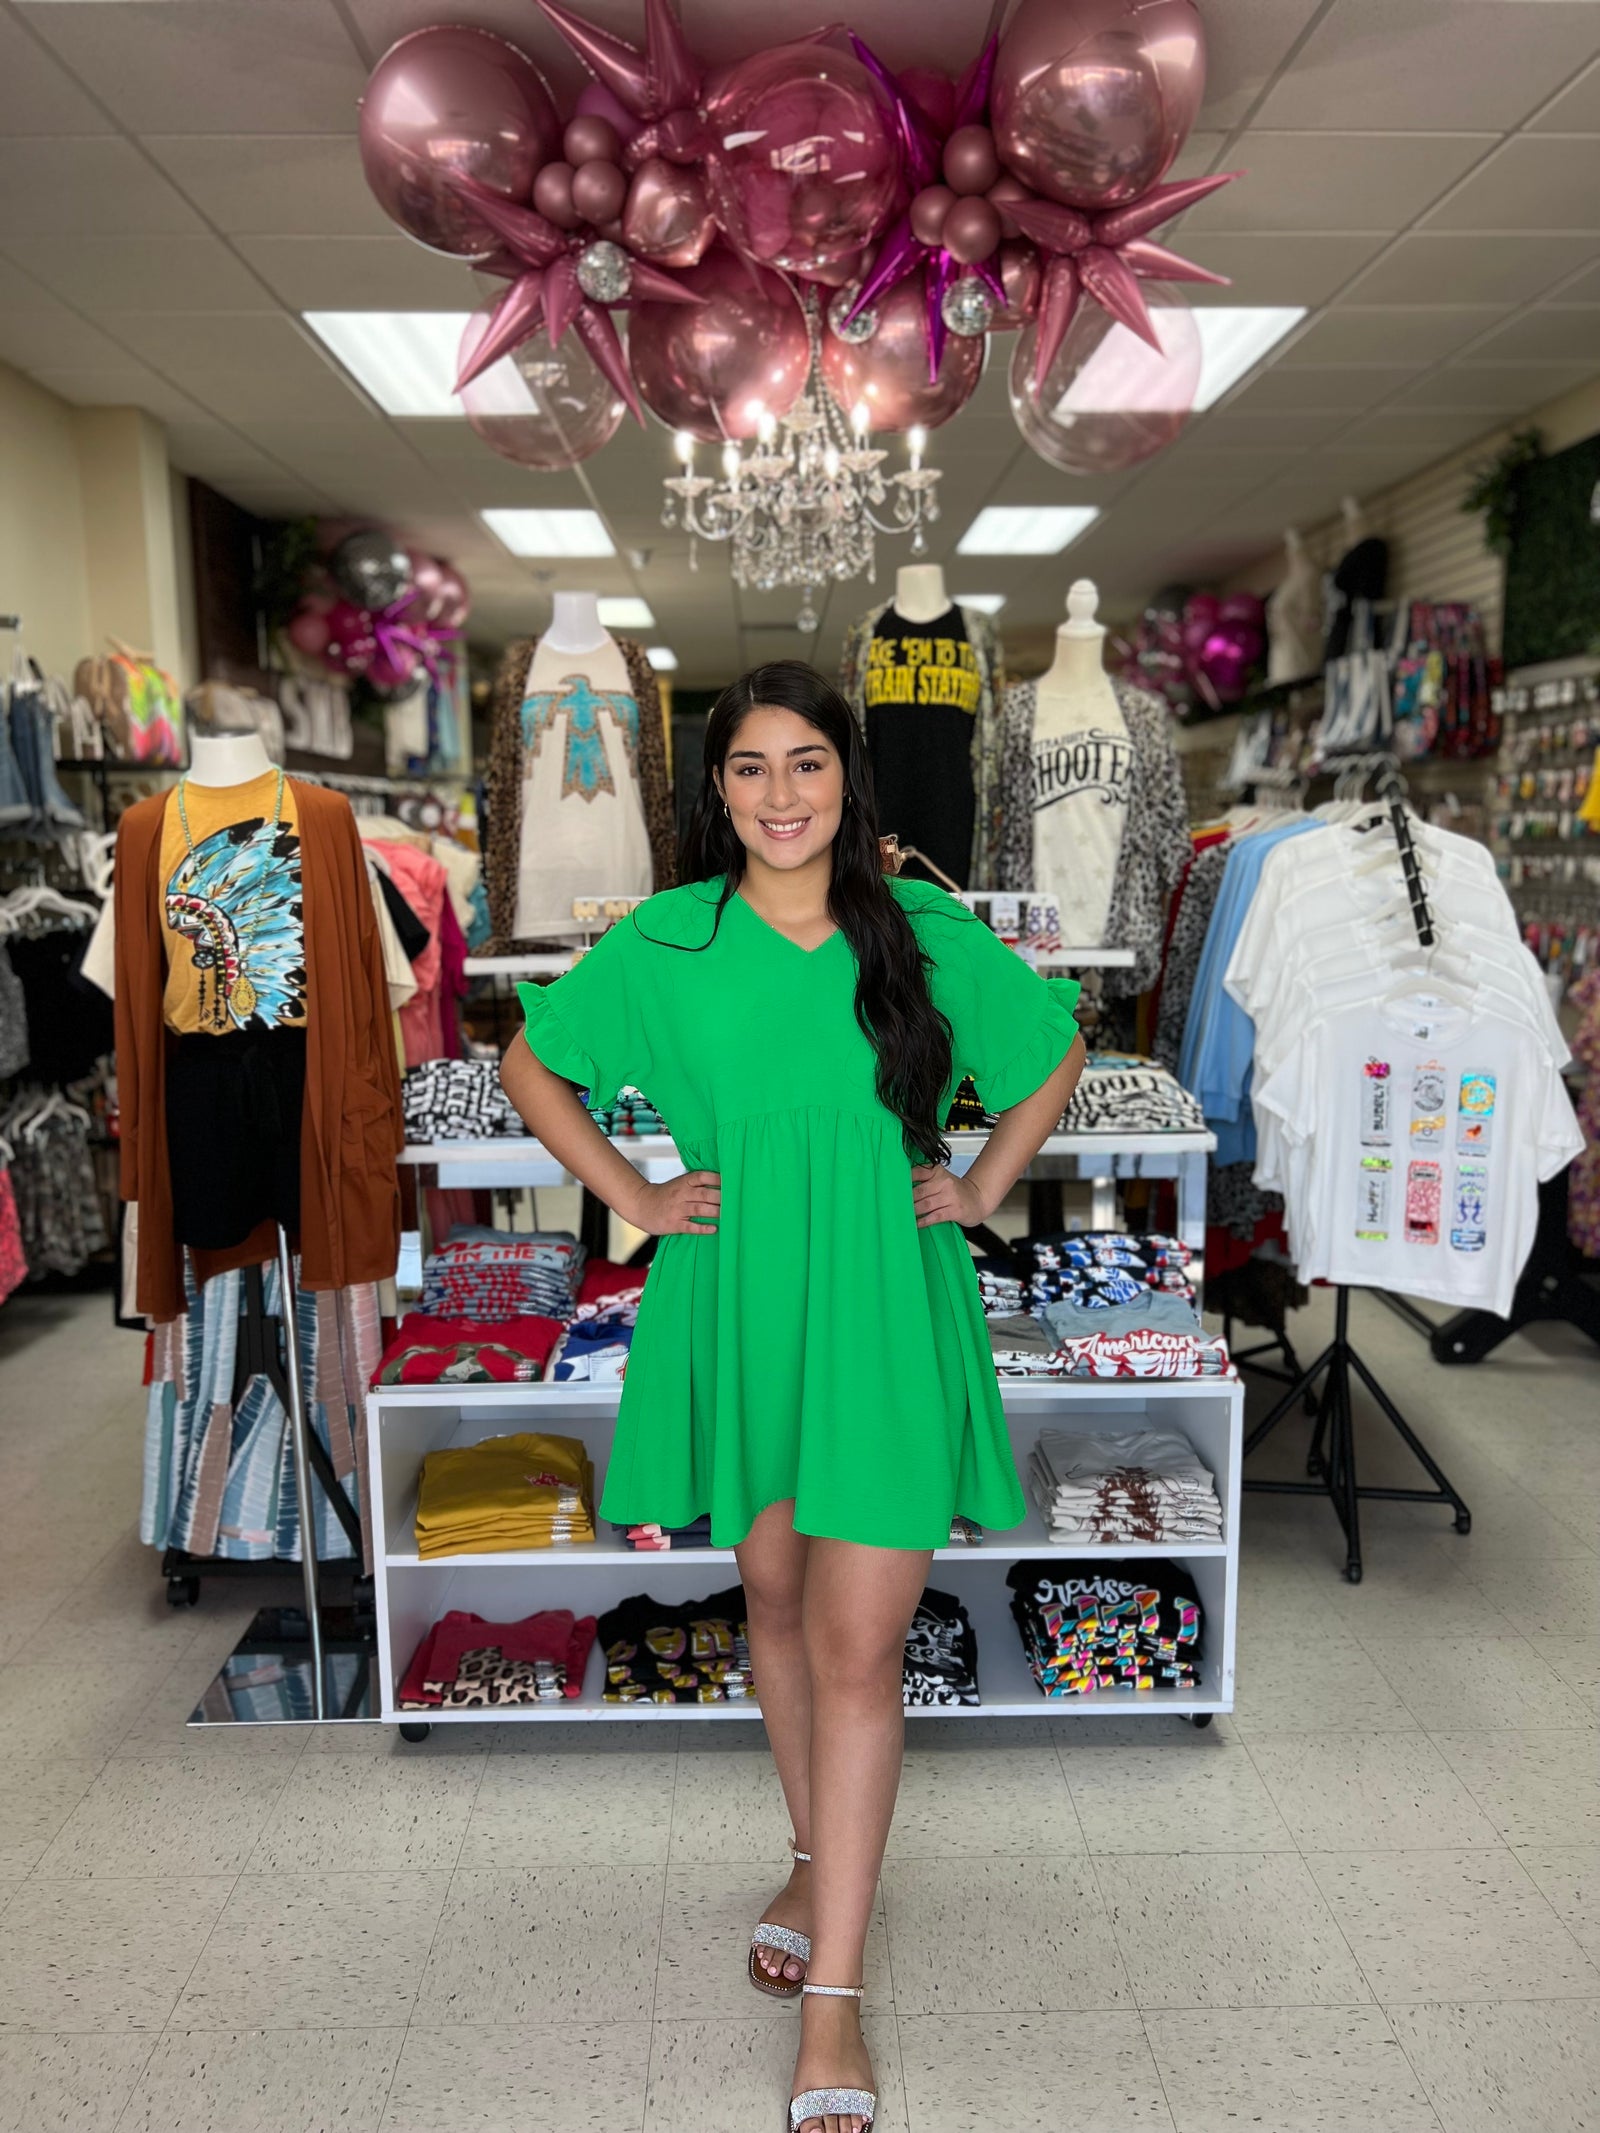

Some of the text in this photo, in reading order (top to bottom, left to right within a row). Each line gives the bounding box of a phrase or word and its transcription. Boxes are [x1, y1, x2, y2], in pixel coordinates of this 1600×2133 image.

[934, 637, 957, 667] TO
[453, 1247, 536, 1264] IN THE
[1064, 1330, 1200, 1363] American
[1034, 1576, 1147, 1607] raise
